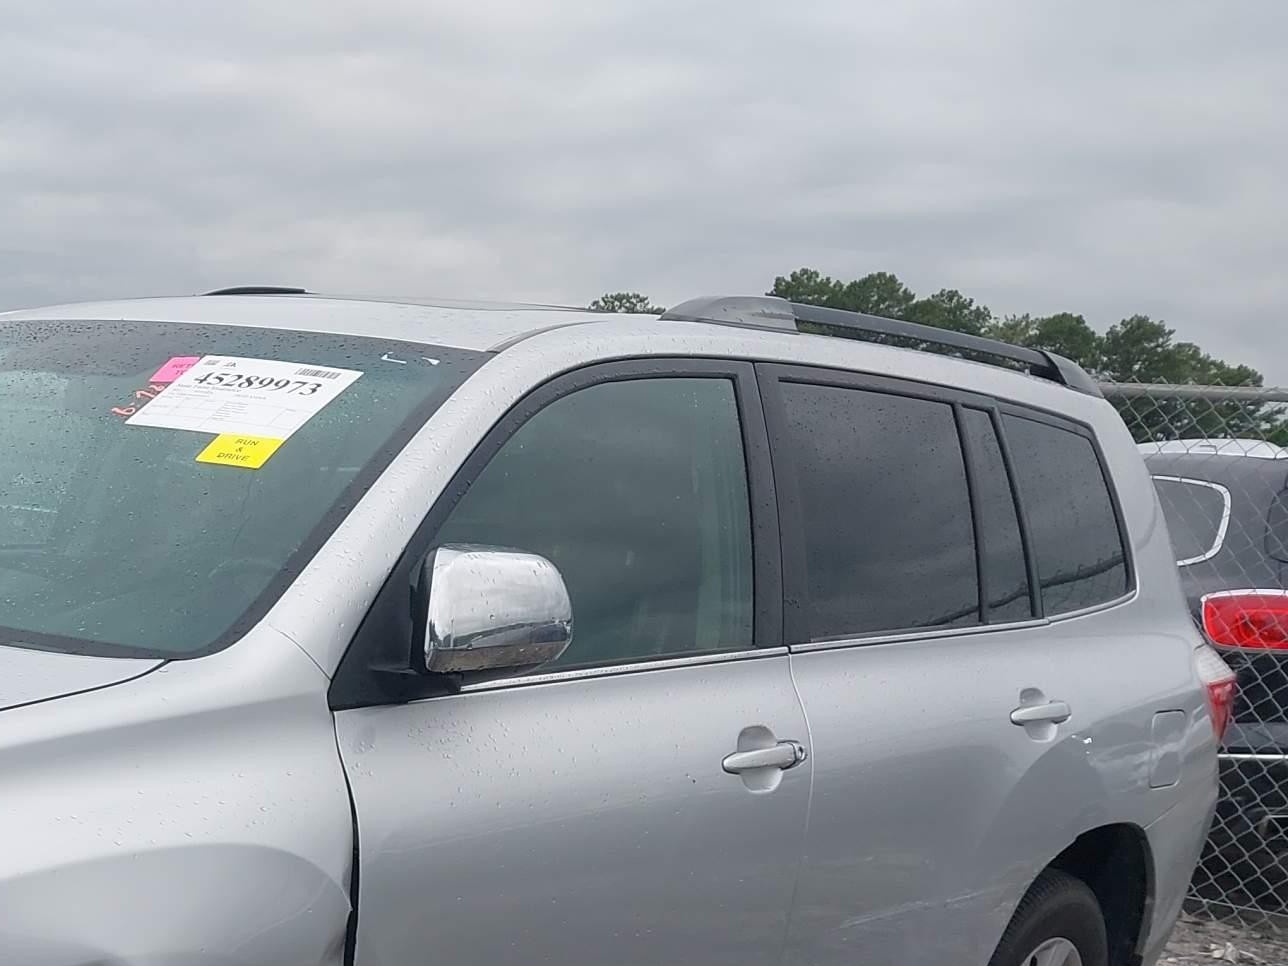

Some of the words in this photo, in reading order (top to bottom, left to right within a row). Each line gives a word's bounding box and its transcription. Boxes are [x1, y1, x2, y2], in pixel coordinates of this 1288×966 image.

[192, 371, 323, 396] 45289973
[234, 438, 260, 446] RUN
[216, 452, 250, 461] DRIVE
